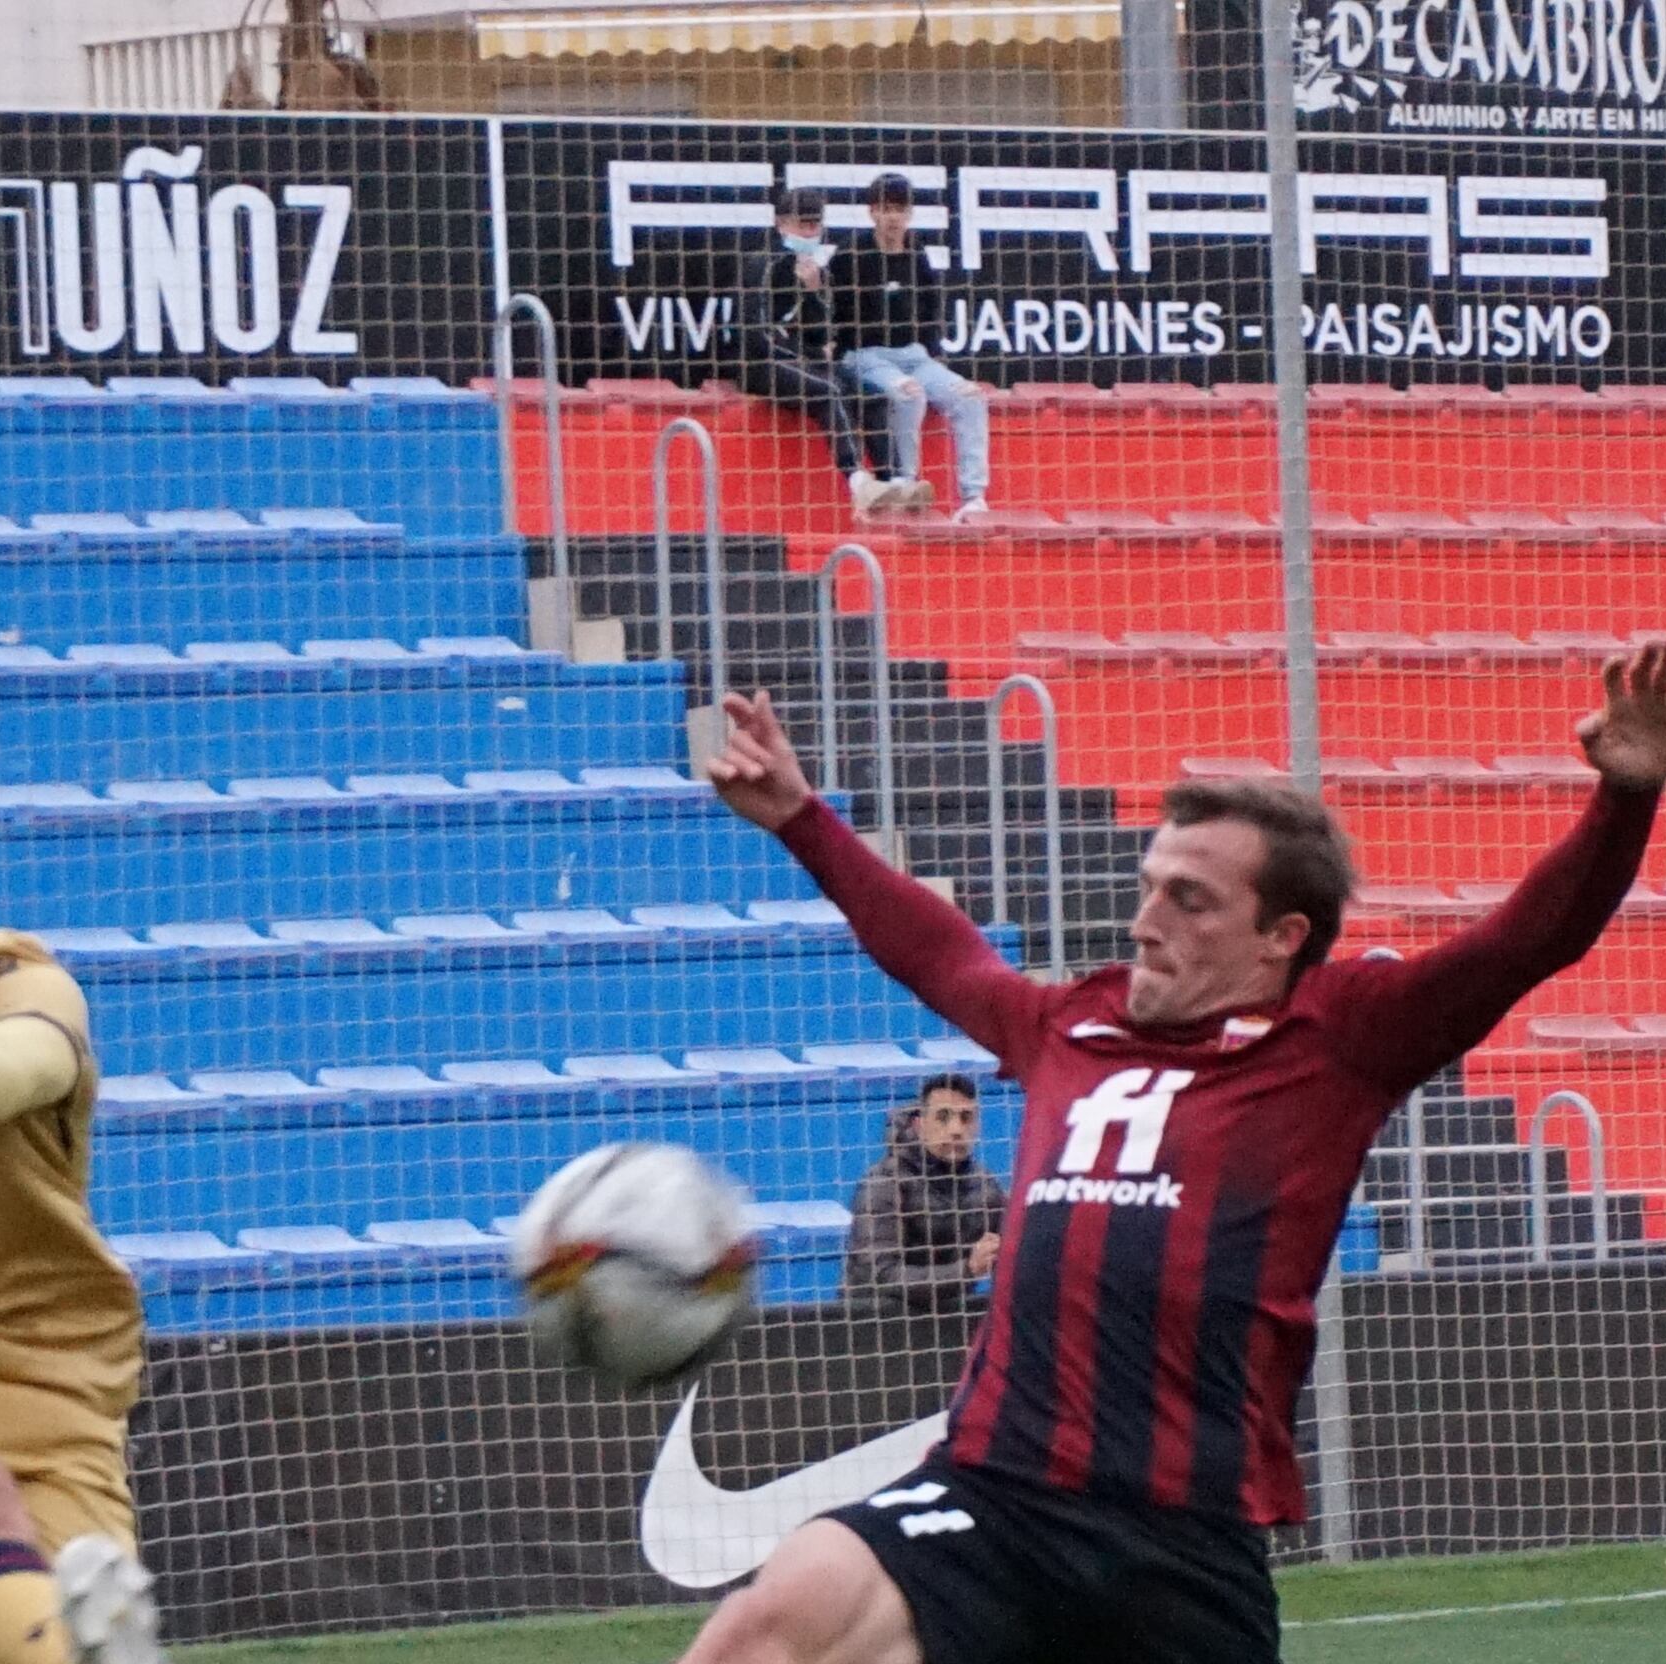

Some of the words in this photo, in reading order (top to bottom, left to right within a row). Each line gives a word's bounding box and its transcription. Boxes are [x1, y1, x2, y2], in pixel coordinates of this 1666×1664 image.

[1389, 103, 1507, 129] ALUMINIO
[1513, 106, 1529, 129] Y
[1534, 107, 1596, 131] ARTE
[1602, 108, 1634, 132] EN
[940, 300, 1224, 355] JARDINES
[1027, 1174, 1183, 1208] network
